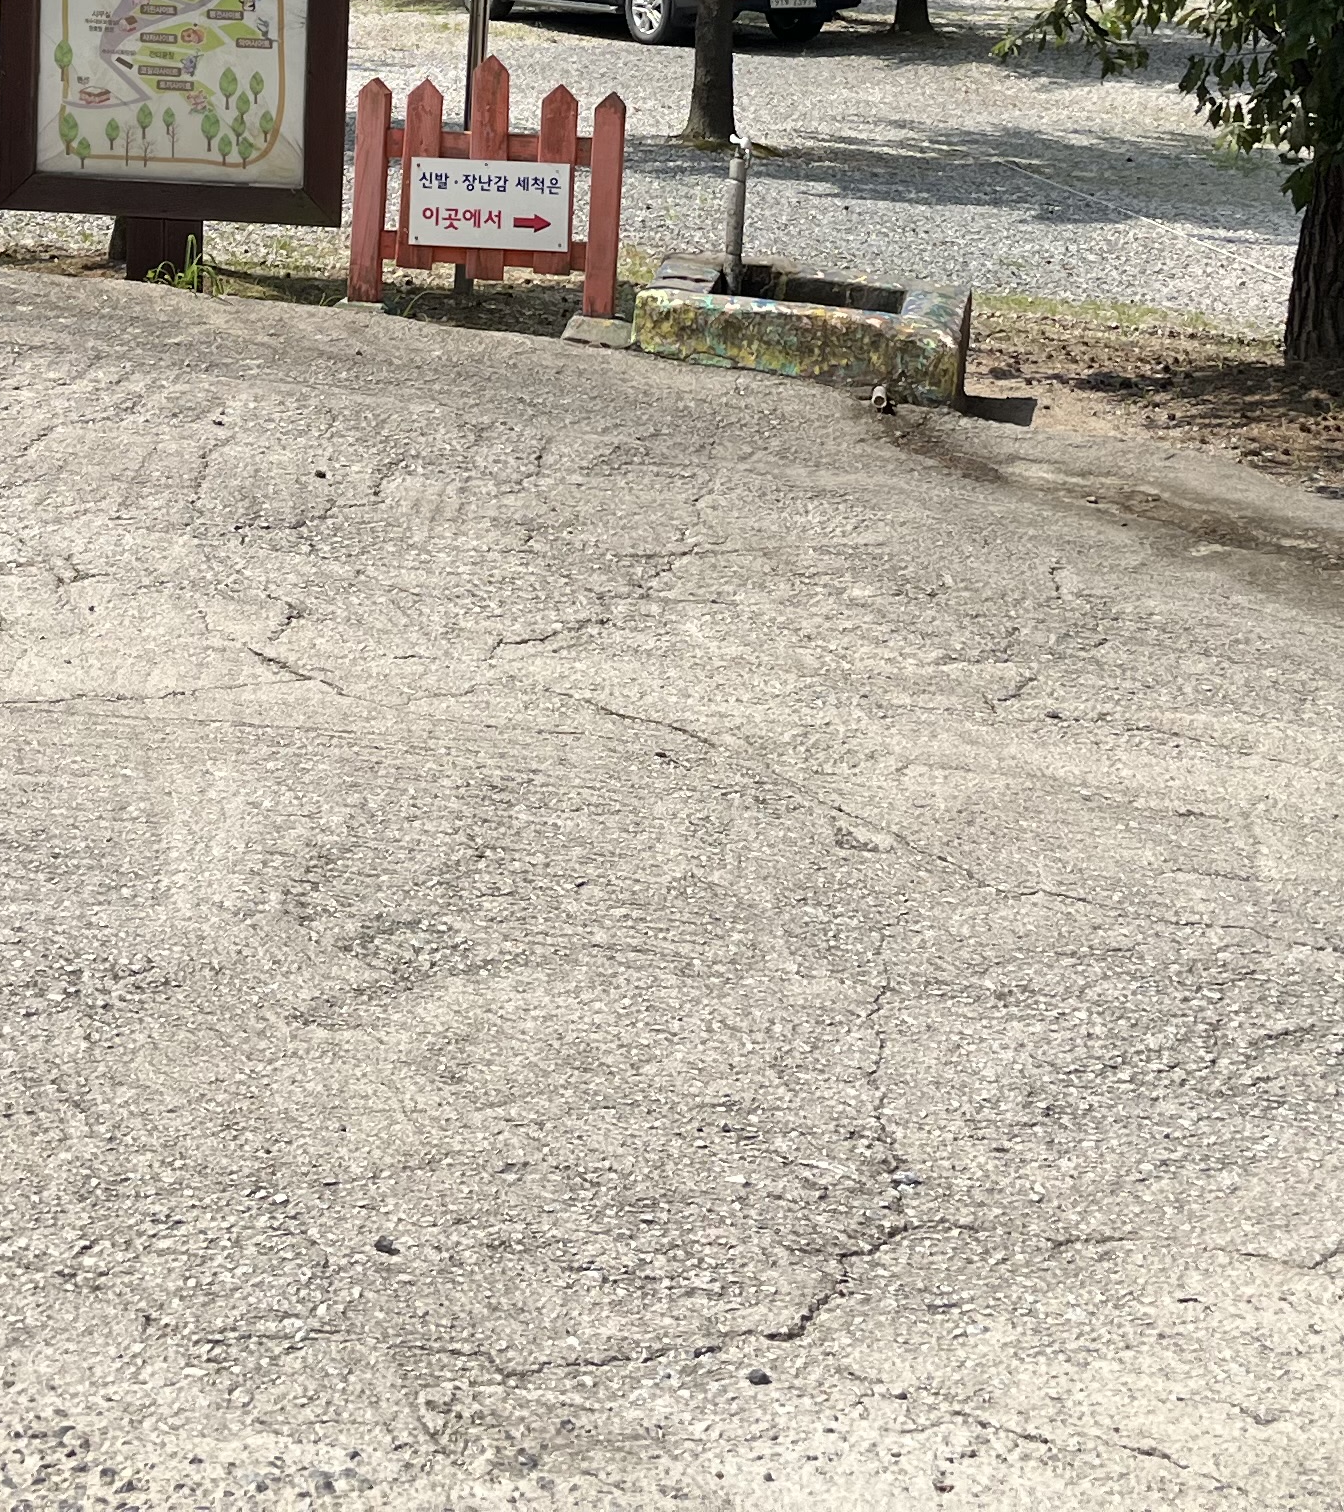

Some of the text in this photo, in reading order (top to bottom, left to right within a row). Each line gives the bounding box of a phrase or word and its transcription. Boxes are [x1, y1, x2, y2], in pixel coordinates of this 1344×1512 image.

[419, 172, 449, 189] 신발
[462, 174, 508, 192] 장난감
[516, 176, 562, 195] 세척은
[422, 206, 502, 230] 이곳에서
